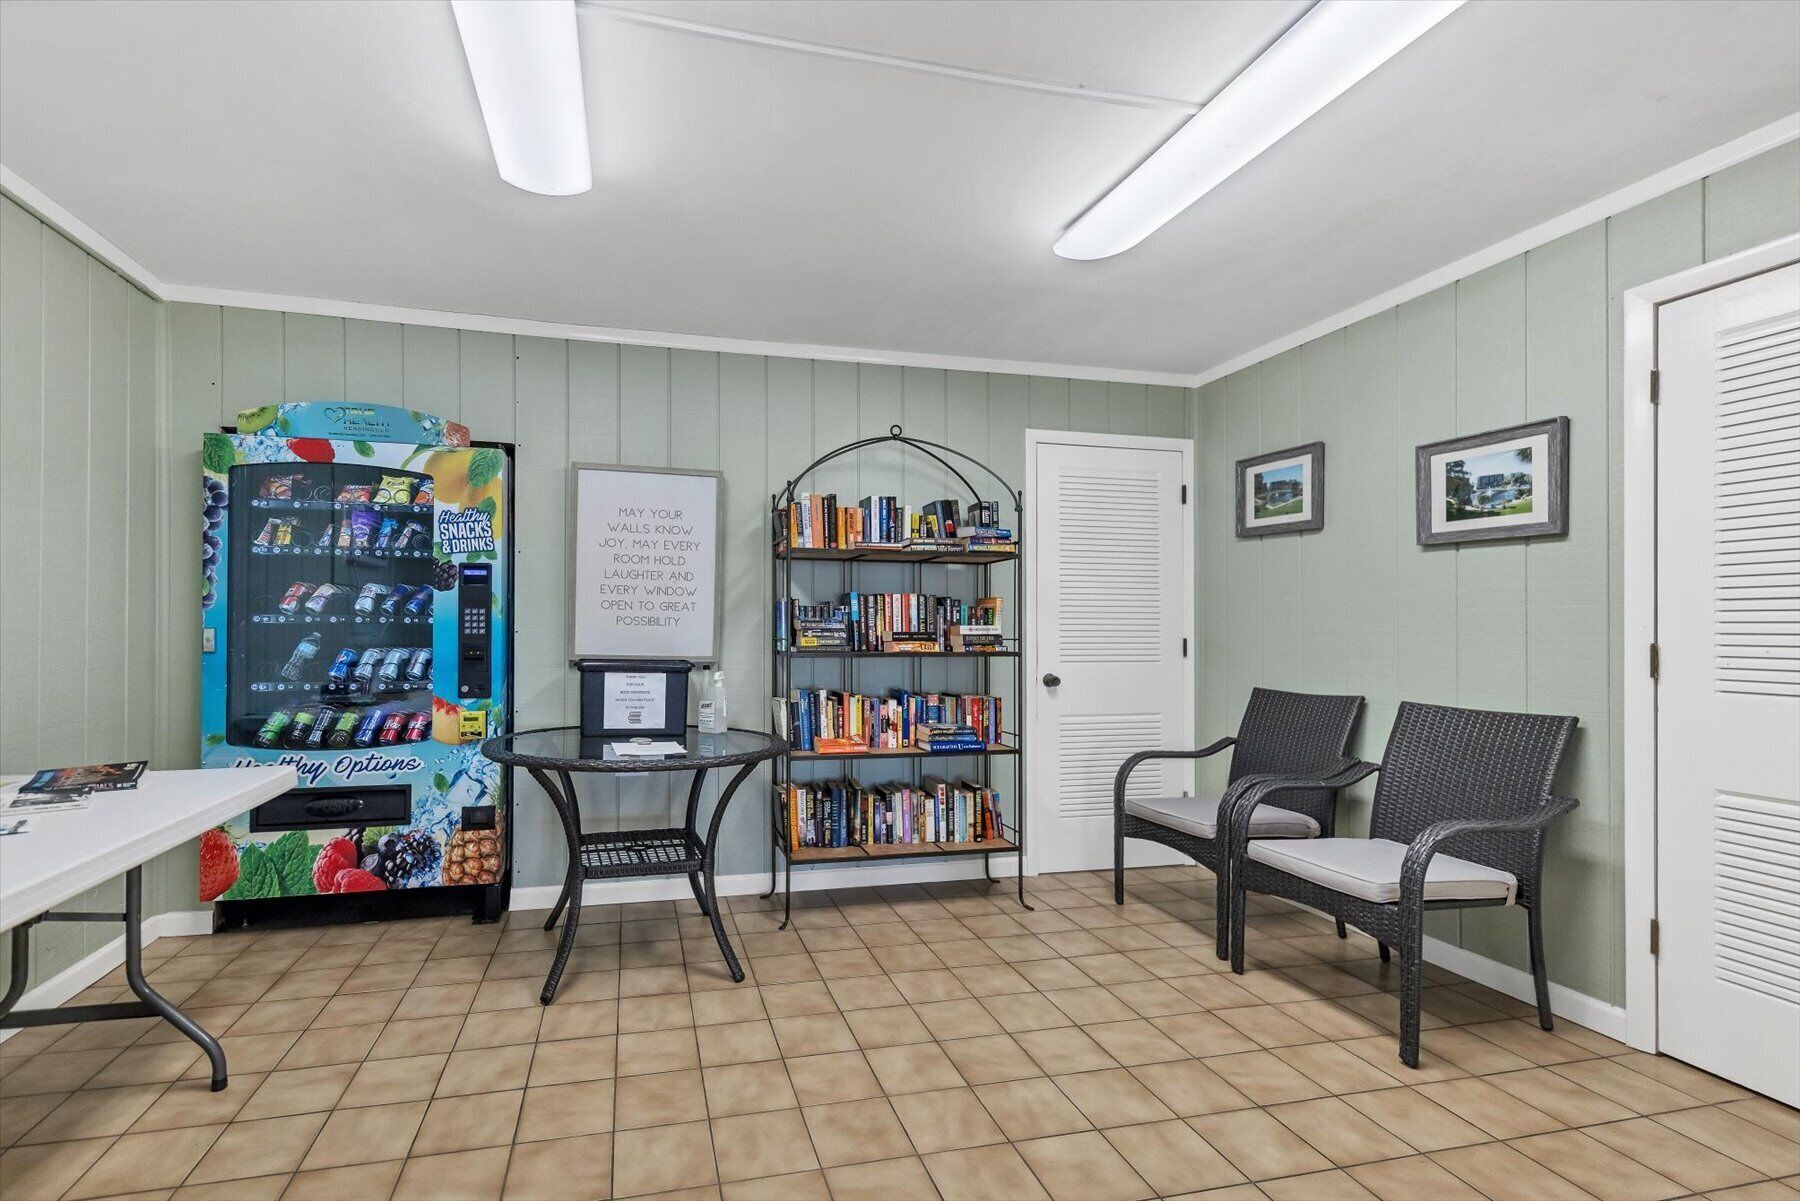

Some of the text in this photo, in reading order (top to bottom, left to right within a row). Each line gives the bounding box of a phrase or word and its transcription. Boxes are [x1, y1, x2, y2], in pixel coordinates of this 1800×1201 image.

[439, 508, 491, 526] Healthy
[618, 507, 684, 520] MAY YOUR
[440, 521, 492, 539] SNACKS
[606, 522, 694, 536] WALLS KNOW
[442, 537, 494, 553] & DRINKS
[632, 539, 659, 550] MAY
[663, 540, 701, 552] EVERY
[613, 553, 686, 566] ROOM HOLD
[604, 568, 695, 582] LAUGHTER AND
[600, 583, 698, 597] EVERY WINDOW
[600, 599, 696, 612] OPEN TO GREAT
[615, 615, 681, 627] POSSIBILITY
[335, 753, 422, 780] Options
